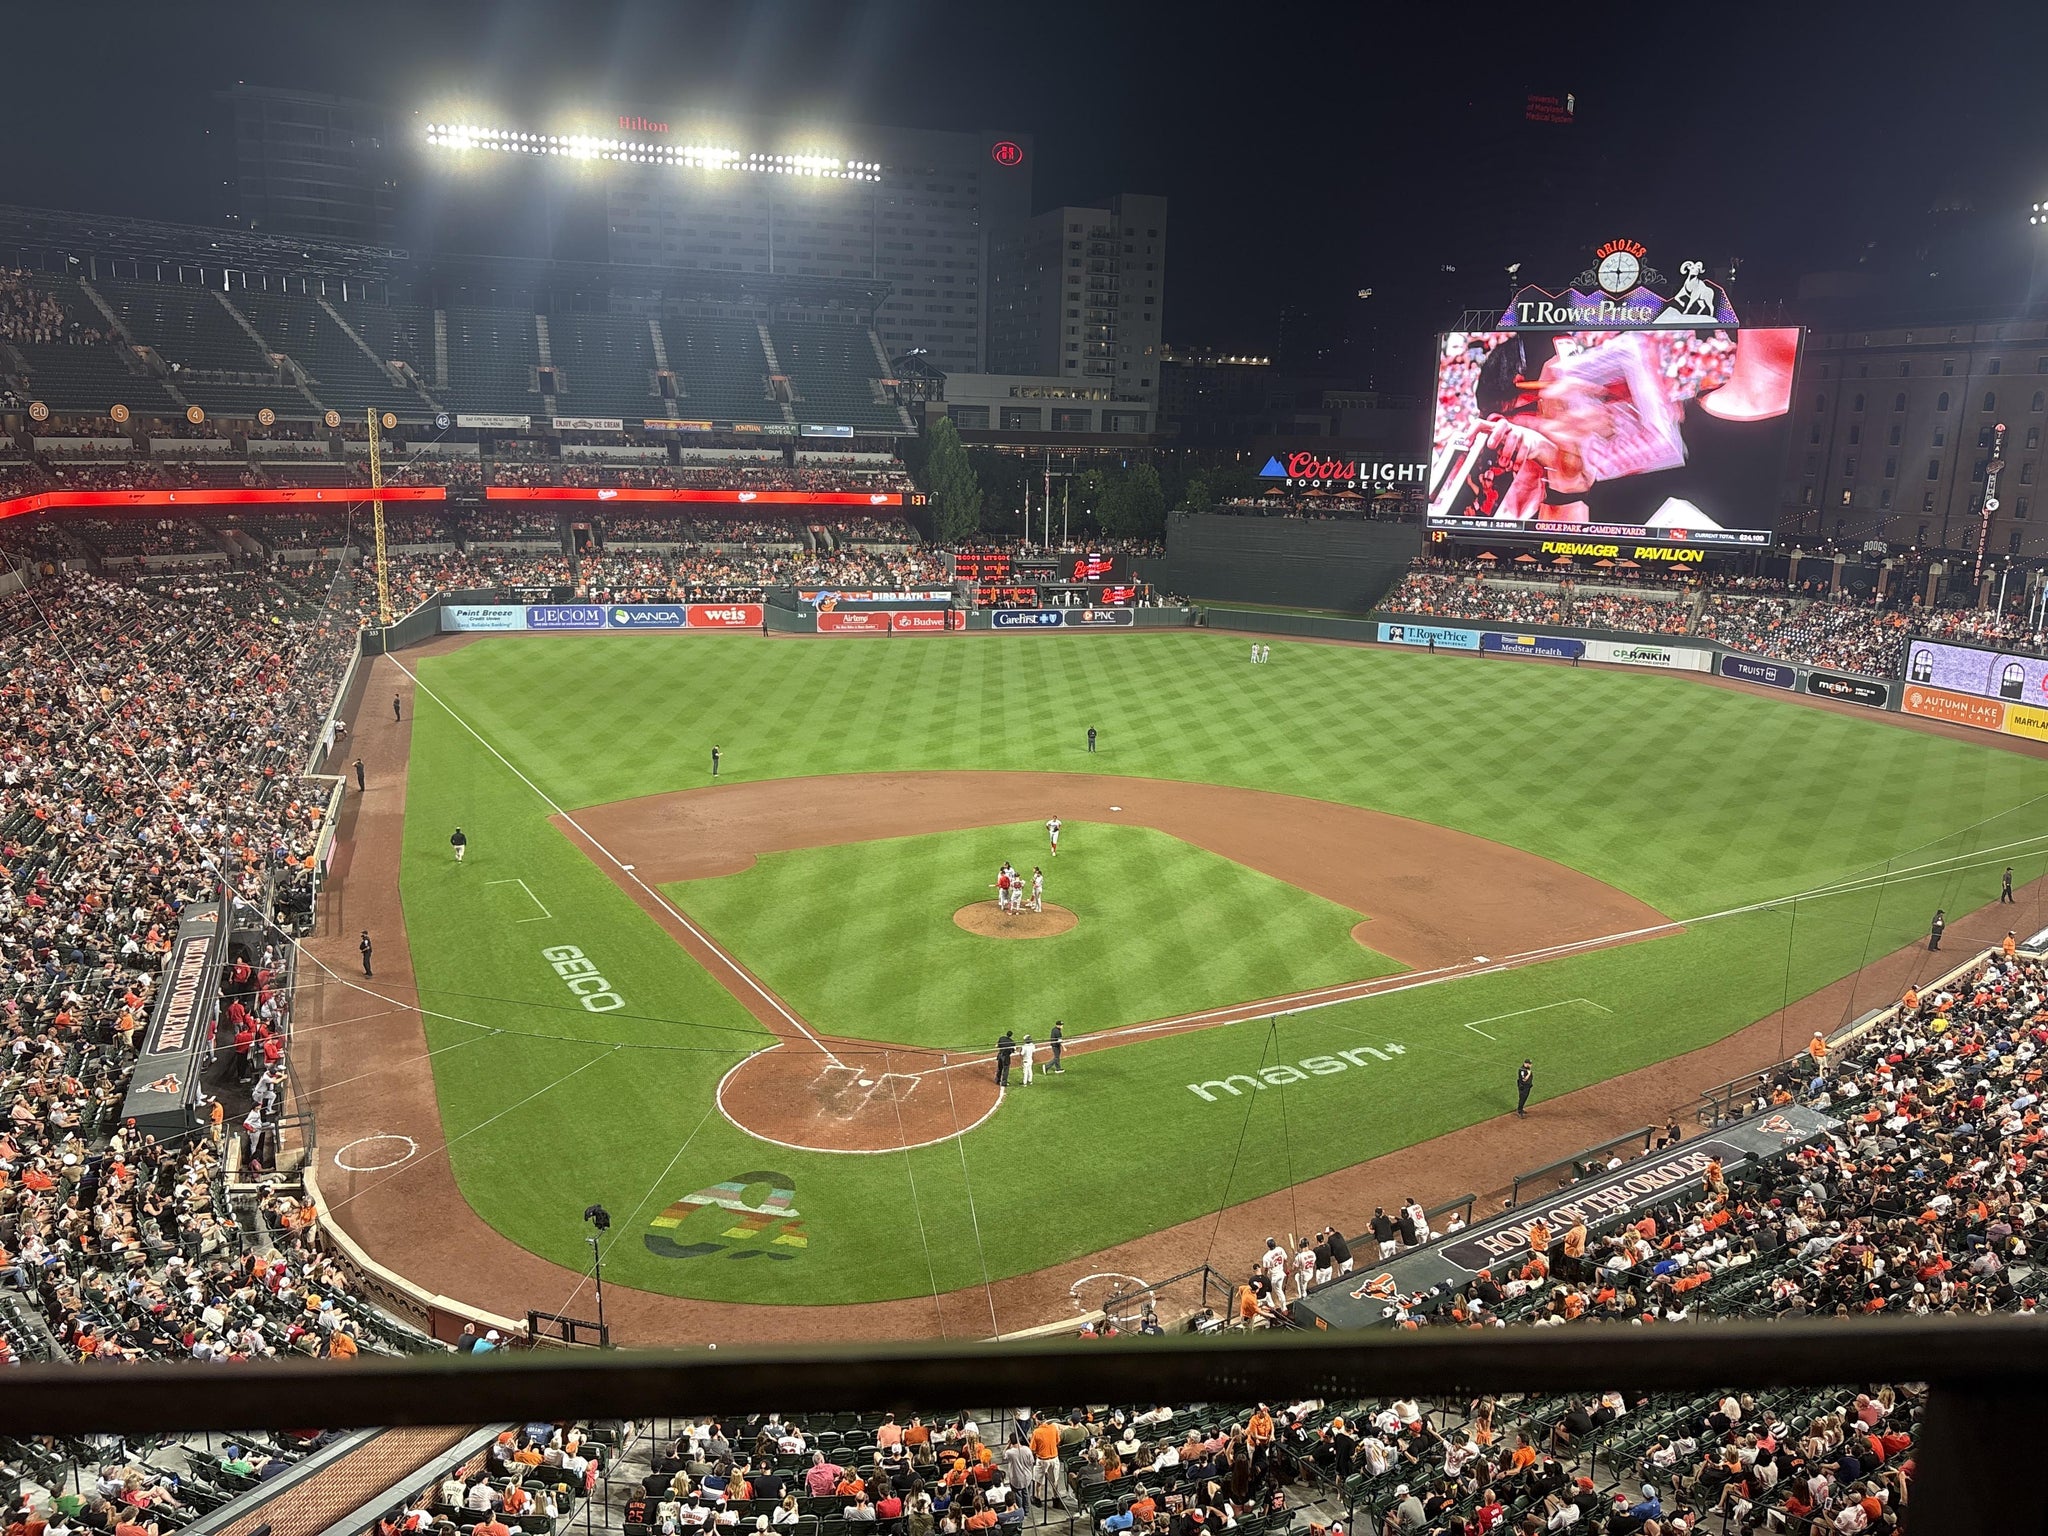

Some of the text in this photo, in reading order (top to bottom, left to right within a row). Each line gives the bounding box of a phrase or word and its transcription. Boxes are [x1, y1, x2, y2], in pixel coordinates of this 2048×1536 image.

[1535, 104, 1564, 113] Maryland
[1526, 112, 1551, 121] Medical
[619, 116, 669, 133] Hilton
[1596, 238, 1647, 259] ORIOLES
[1597, 300, 1653, 323] Price
[33, 406, 47, 417] 20
[116, 408, 124, 418] 5
[192, 410, 199, 419] 4
[261, 412, 273, 421] 22
[328, 414, 339, 423] 33
[387, 416, 393, 425] 8
[438, 416, 449, 426] 42
[555, 420, 571, 428] ENJOY
[594, 420, 604, 428] ICE
[604, 421, 621, 429] CREAM
[1993, 431, 2003, 459] TEAM
[1288, 451, 1428, 482] Coors LIGHT
[1286, 479, 1395, 490] ROOF DECK
[1535, 522, 1563, 532] ORIOLE
[1563, 524, 1582, 533] PARK
[1590, 525, 1621, 535] CAMDEN
[1622, 527, 1647, 536] YARDS
[1541, 541, 1705, 562] PUREWAGER PAVILION
[872, 592, 897, 600] BIRD
[898, 592, 923, 601] BATH
[456, 609, 480, 617] Point
[533, 610, 600, 623] LECOM
[630, 611, 680, 621] VANDA
[704, 607, 746, 621] weis
[843, 614, 869, 623] Airtemp
[1094, 611, 1115, 620] PNC
[1000, 614, 1038, 624] CareFirst
[1444, 630, 1468, 641] Price
[1501, 644, 1562, 656] MedStar Health
[1629, 651, 1671, 662] RANKIN
[1738, 664, 1765, 677] TRUIST
[1925, 696, 1997, 718] AUTUMN LAKE
[1923, 705, 1997, 724] HEALTHCARE
[175, 976, 201, 991] TO
[541, 945, 626, 1012] GEICO
[164, 990, 197, 1025] ORIOLE
[156, 1022, 188, 1052] PARK
[1548, 1203, 1589, 1230] OF
[1578, 1182, 1639, 1213] THE
[1623, 1151, 1714, 1194] ORIOLES
[627, 1510, 645, 1523] 25
